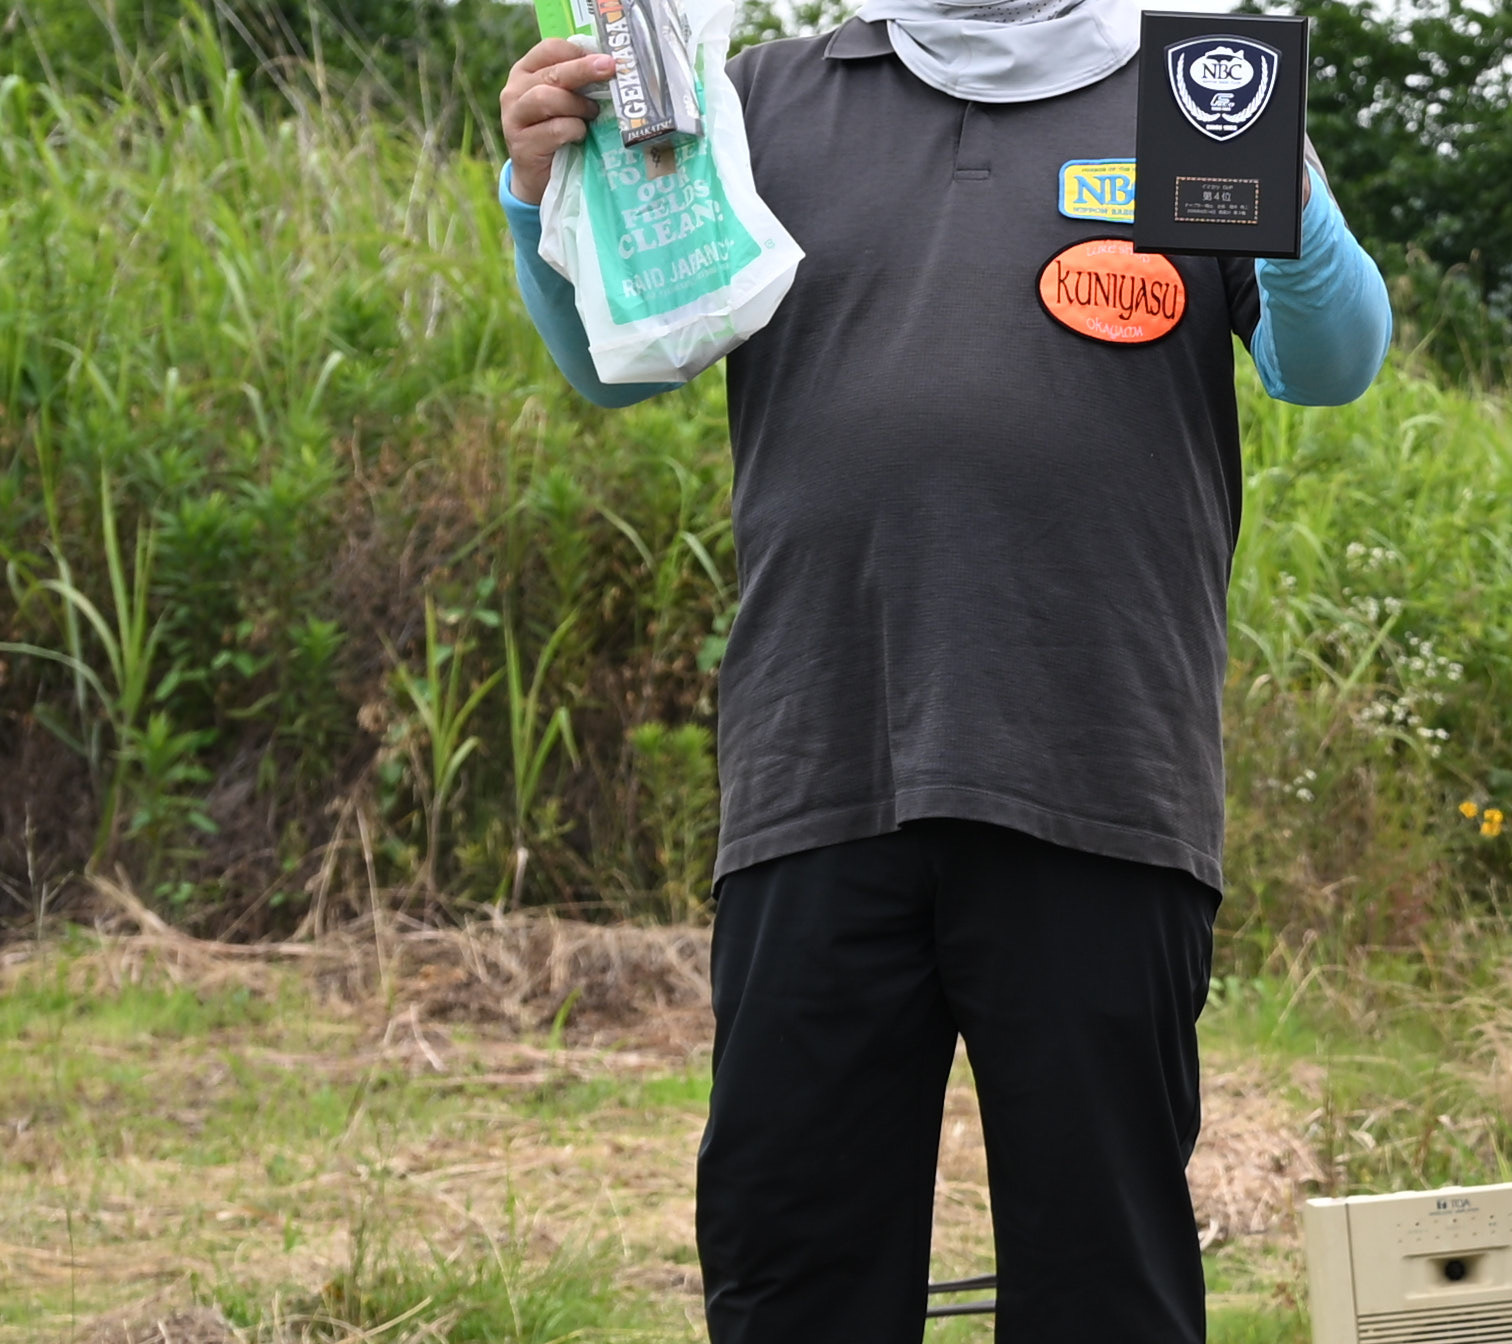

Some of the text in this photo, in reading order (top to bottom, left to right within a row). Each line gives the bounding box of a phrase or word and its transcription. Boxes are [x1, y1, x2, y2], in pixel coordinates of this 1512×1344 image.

[1202, 63, 1242, 80] NBC
[1073, 175, 1136, 205] NB
[622, 267, 665, 299] RAID
[669, 241, 719, 282] JAPAN
